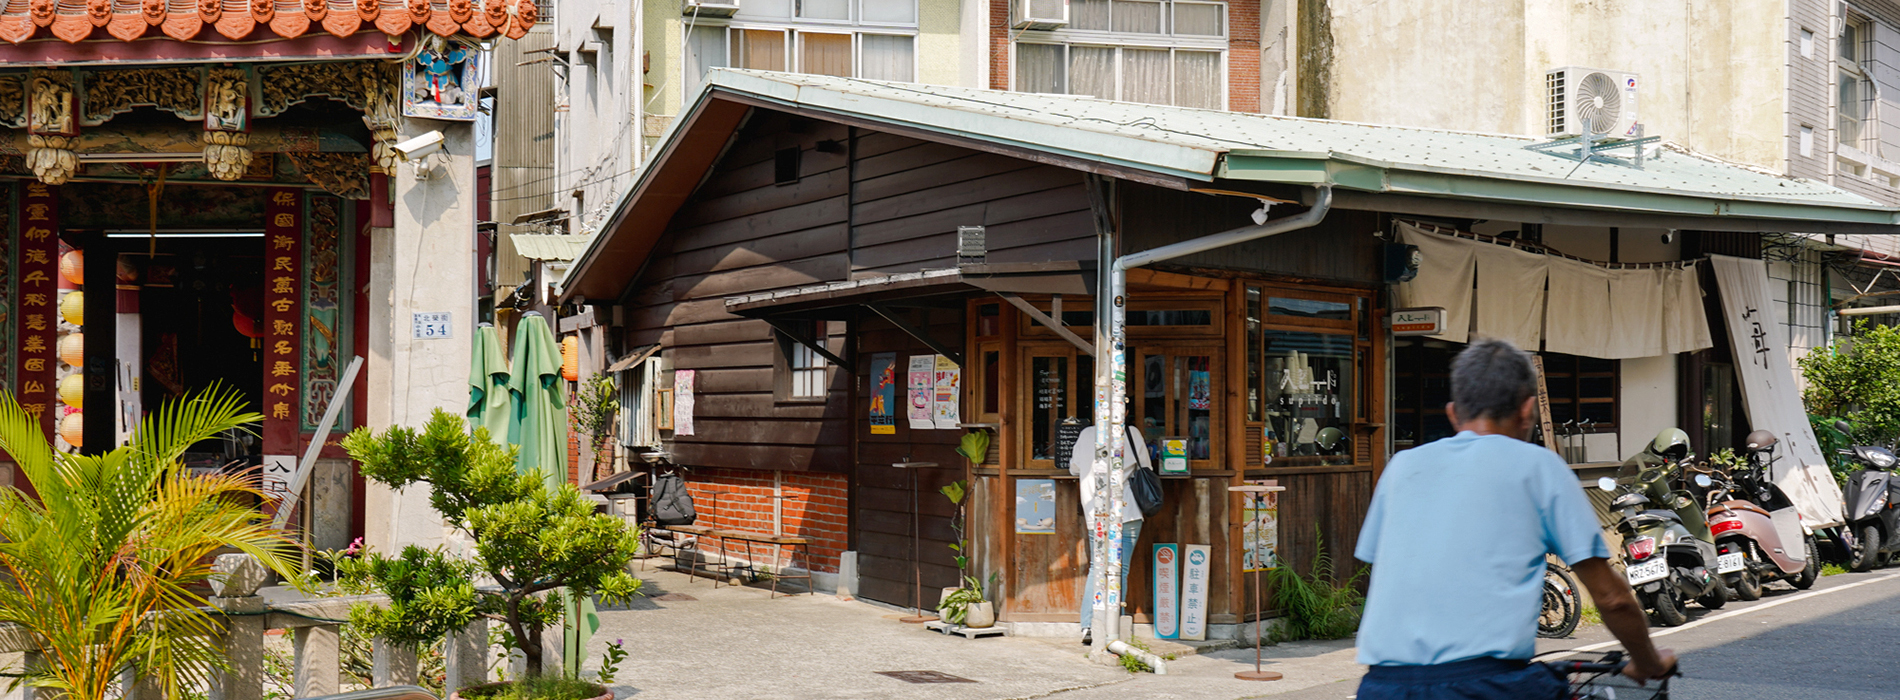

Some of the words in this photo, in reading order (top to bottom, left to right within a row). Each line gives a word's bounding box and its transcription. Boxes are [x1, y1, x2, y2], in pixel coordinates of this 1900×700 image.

[426, 323, 447, 336] 54
[1280, 395, 1336, 408] supiido
[269, 460, 291, 492] 入口
[1629, 562, 1666, 580] MRZ-5678
[1186, 568, 1200, 624] 駐車禁止
